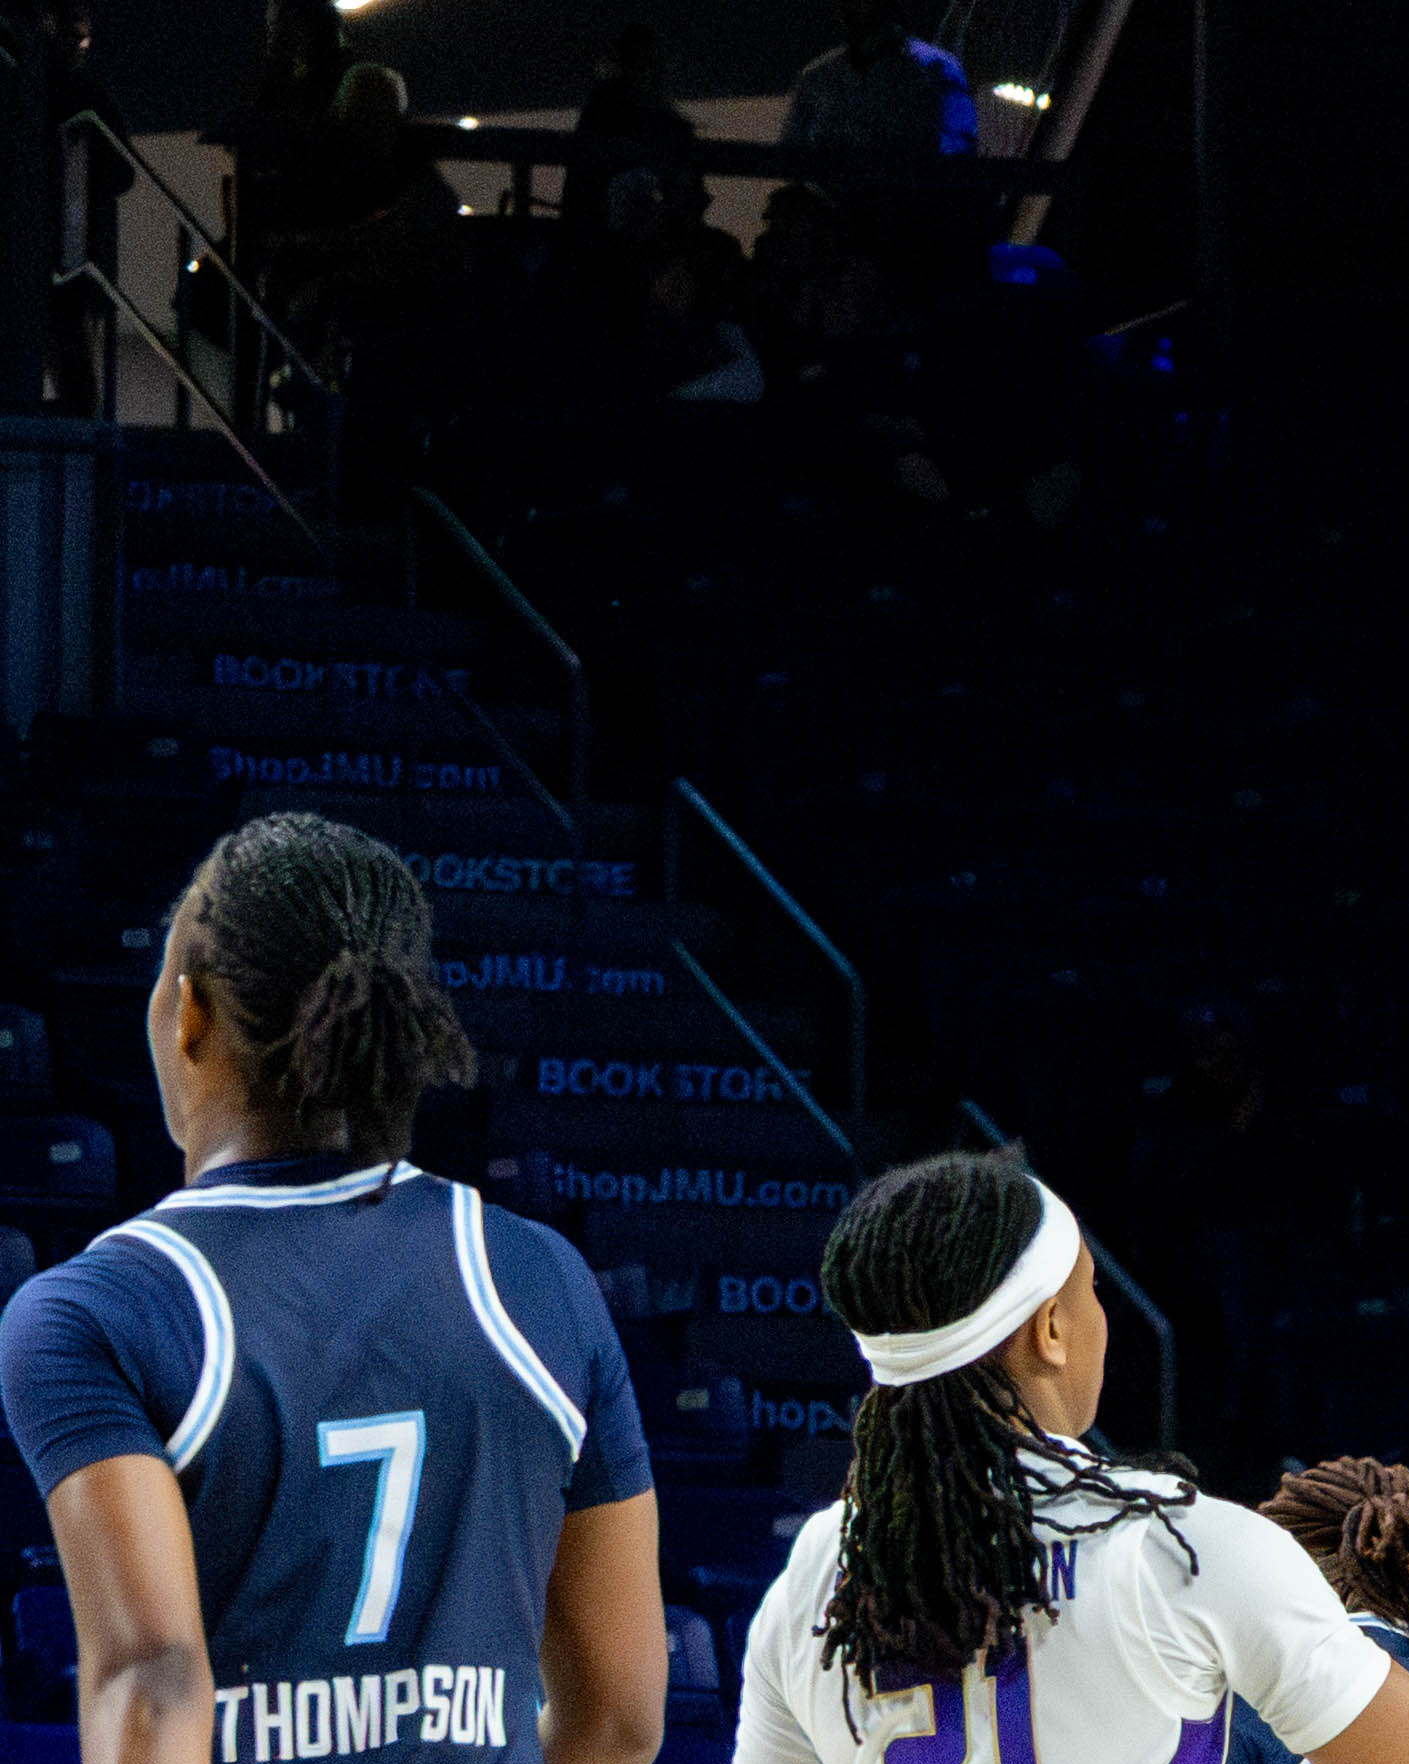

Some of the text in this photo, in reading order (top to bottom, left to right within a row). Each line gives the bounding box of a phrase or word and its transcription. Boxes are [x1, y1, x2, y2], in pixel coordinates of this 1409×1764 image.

[405, 852, 637, 897] OOKSTORE
[718, 1275, 832, 1313] BOO
[316, 1410, 427, 1646] 7
[214, 1664, 508, 1763] THOMPSON
